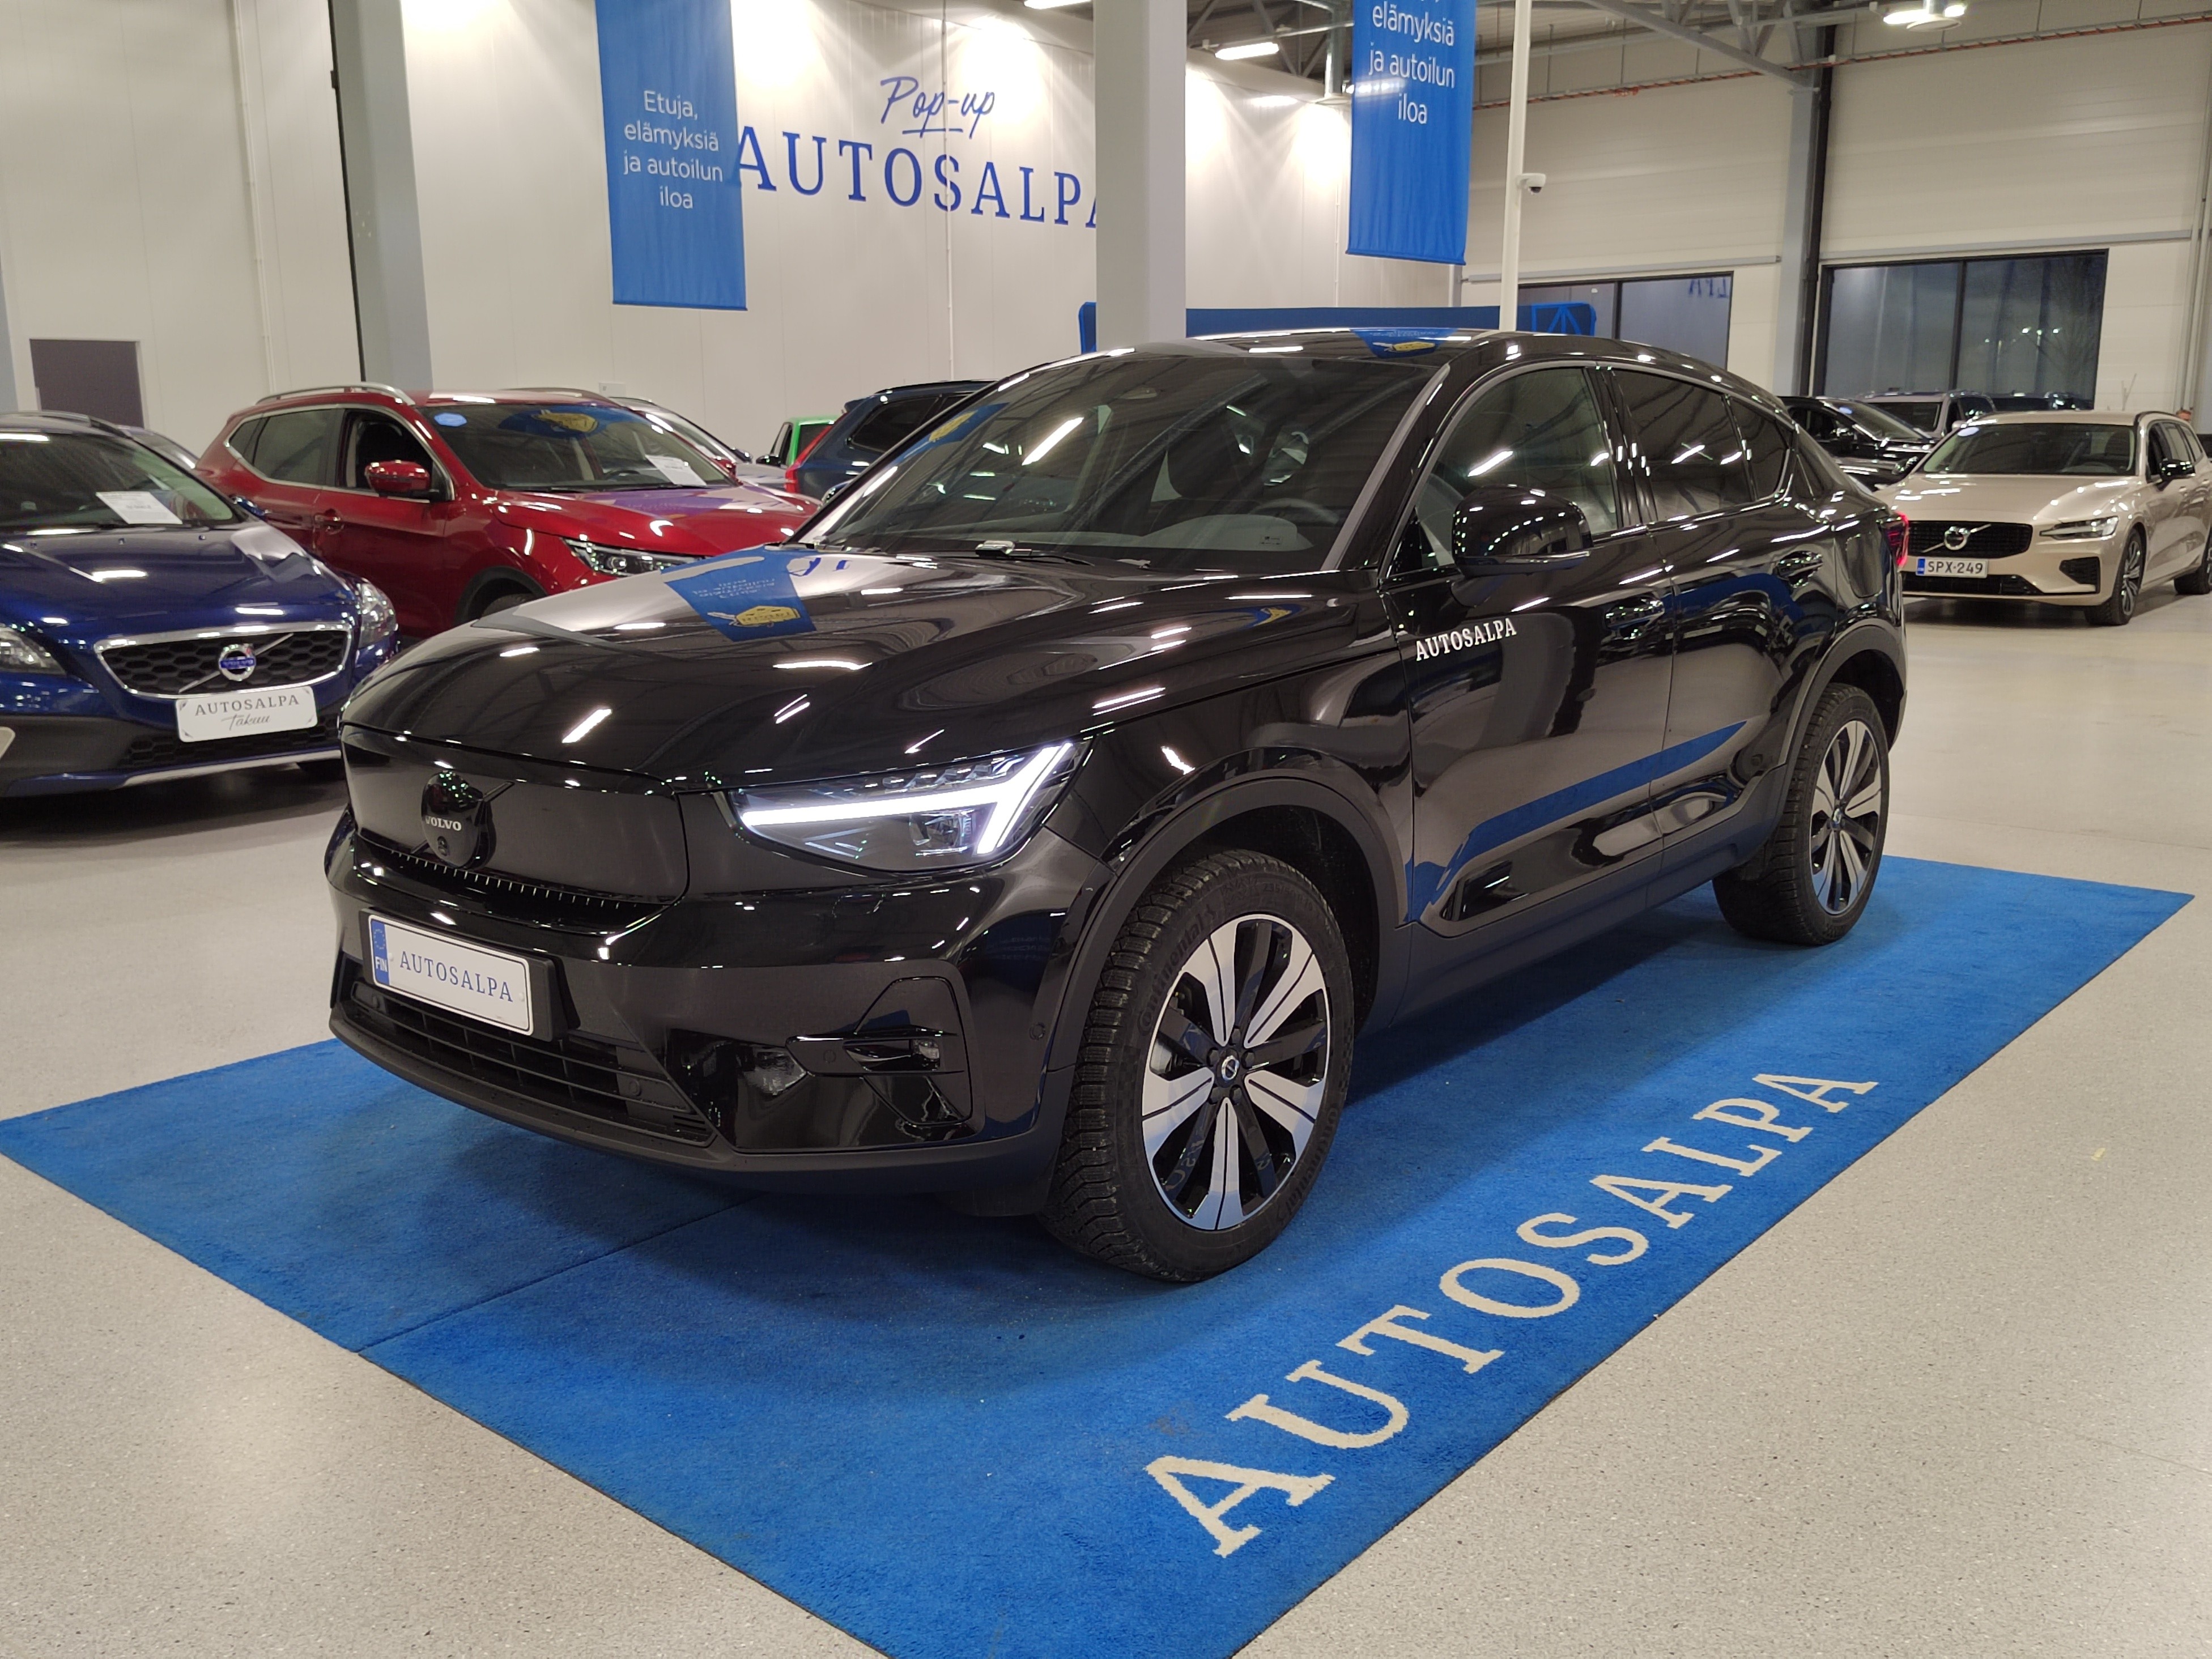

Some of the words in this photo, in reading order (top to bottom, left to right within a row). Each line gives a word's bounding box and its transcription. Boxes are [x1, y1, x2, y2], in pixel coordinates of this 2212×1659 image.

[1372, 1, 1454, 46] elämyksiä
[1368, 41, 1384, 75] ja
[1390, 53, 1455, 88] autoilun
[644, 90, 698, 120] Etuja,
[880, 76, 995, 139] Pop-up
[1398, 93, 1427, 124] iloa
[624, 120, 719, 151] elämyksiä
[623, 149, 641, 175] ja
[647, 157, 723, 182] autoilun
[660, 185, 693, 209] iloa
[1928, 561, 1983, 574] SPX-249
[1416, 618, 1517, 661] AUTOSALPA
[195, 695, 299, 716] AUTOSALPA
[425, 815, 462, 831] VOLVO
[375, 956, 388, 972] FIN
[399, 951, 513, 1002] AUTOSALPA
[1145, 1073, 1878, 1558] AUTOSALPA
